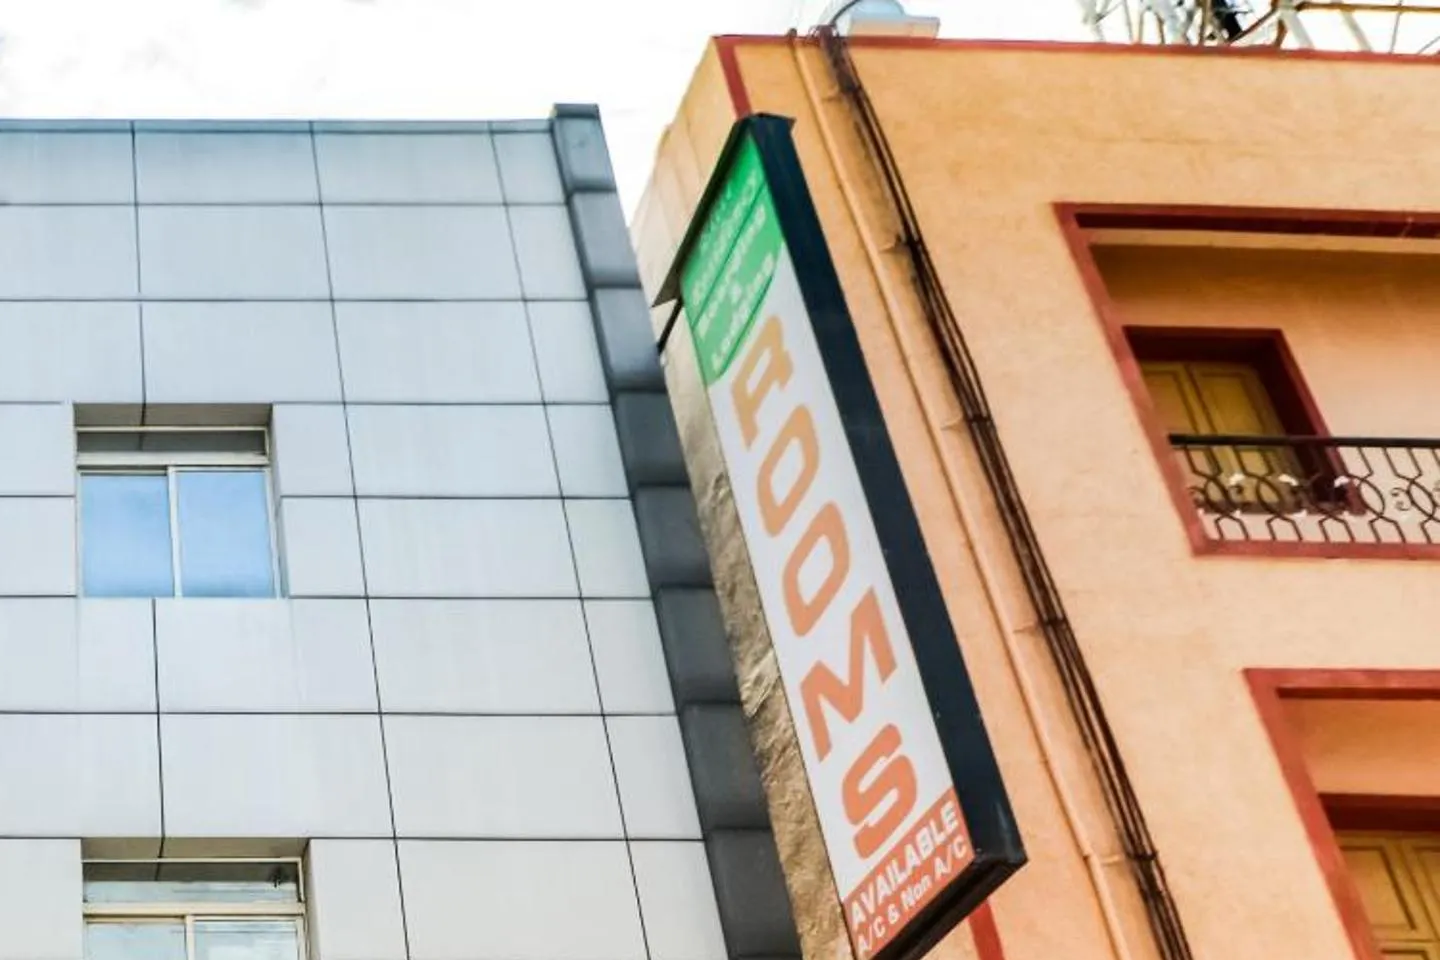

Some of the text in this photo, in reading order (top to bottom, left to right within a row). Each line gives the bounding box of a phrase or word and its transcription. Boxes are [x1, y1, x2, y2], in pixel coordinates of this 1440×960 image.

[731, 313, 917, 860] ROOMS
[851, 801, 959, 931] AVAILABLE
[857, 835, 967, 956] A/C & Non A/C
